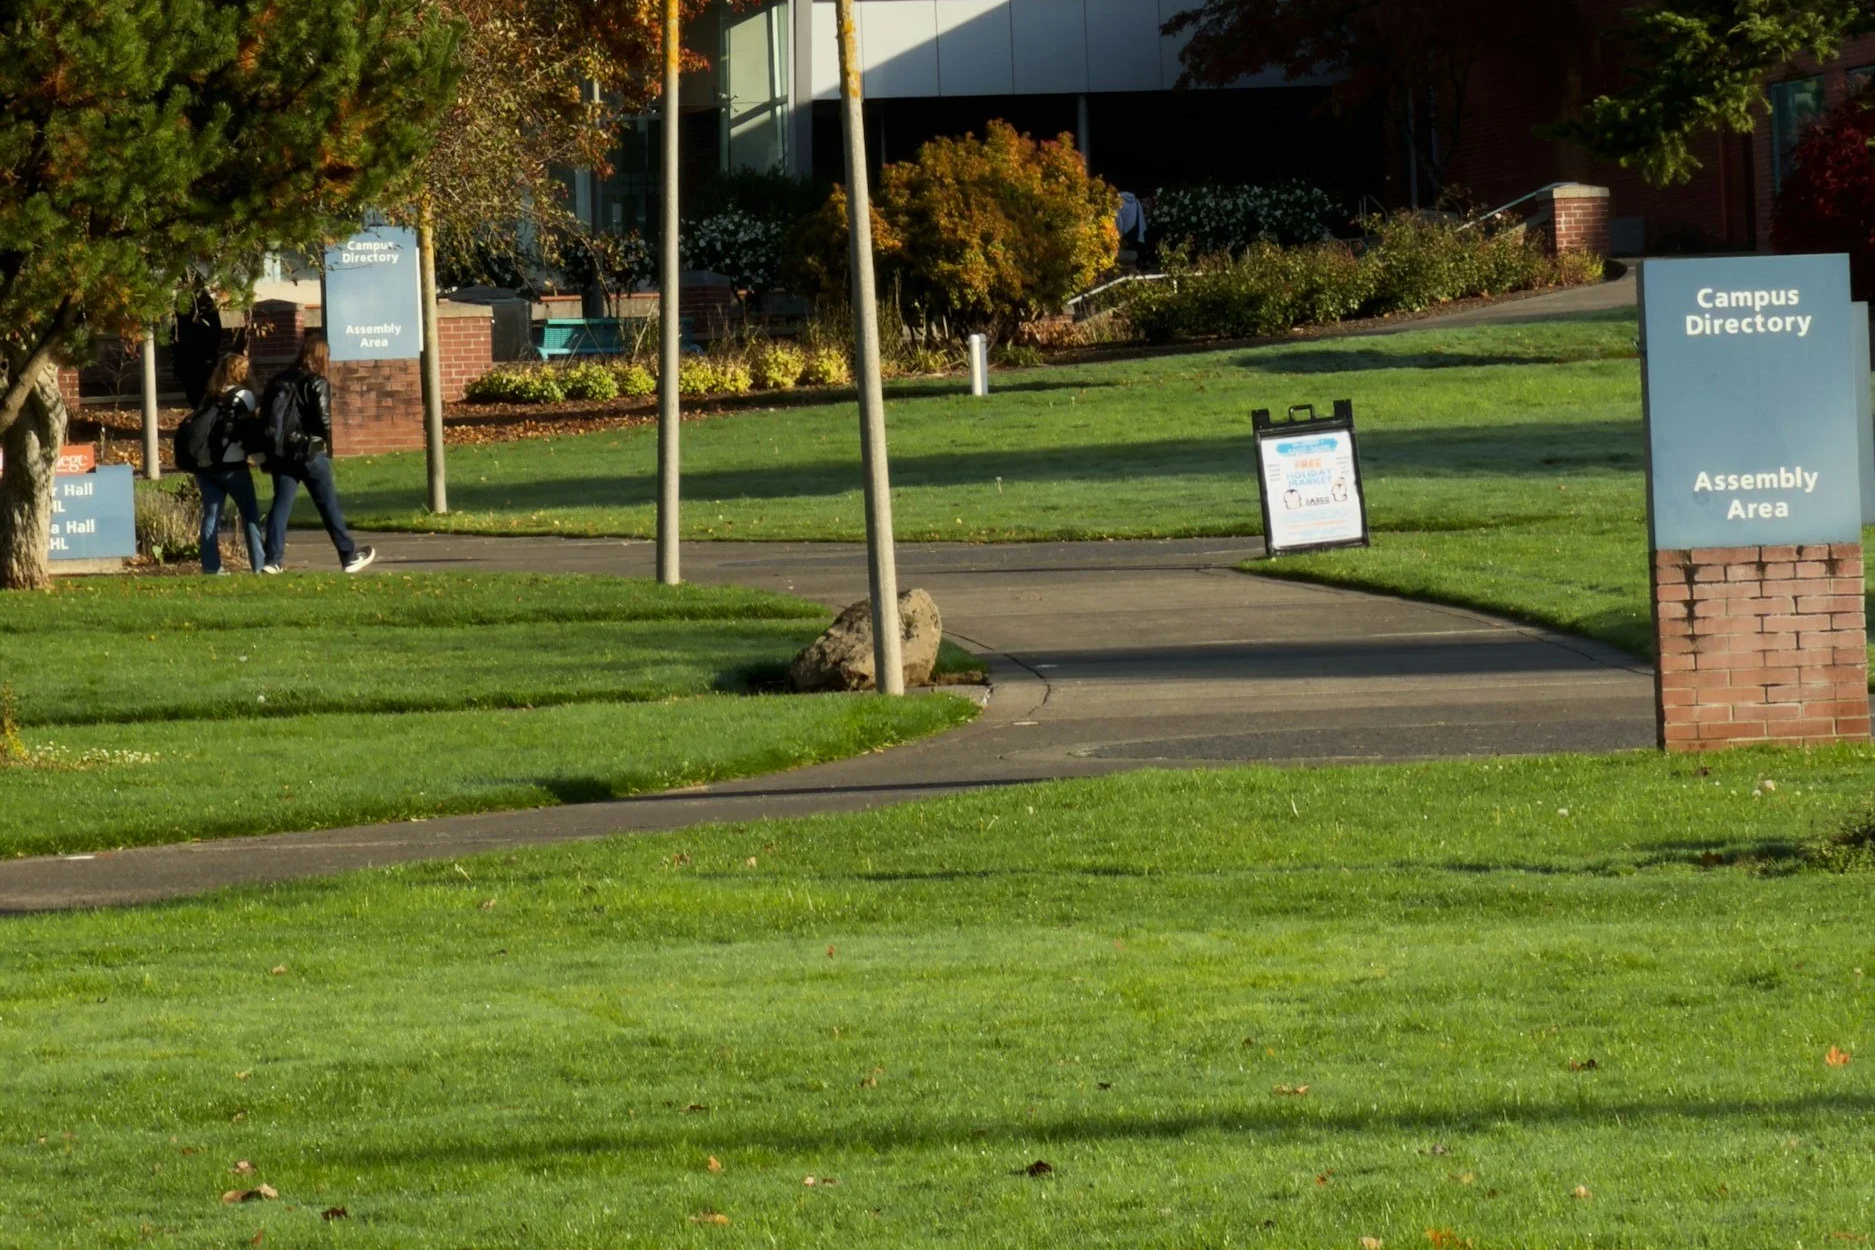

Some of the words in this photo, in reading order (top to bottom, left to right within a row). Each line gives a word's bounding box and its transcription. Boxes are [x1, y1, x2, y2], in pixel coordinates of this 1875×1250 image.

[347, 241, 395, 253] Campus
[342, 252, 400, 264] Directory
[1697, 288, 1800, 312] Campus
[345, 322, 402, 336] Assembly
[1685, 314, 1812, 337] Directory
[360, 337, 389, 348] Area
[1694, 466, 1819, 493] Assembly
[64, 482, 94, 497] Hall
[1727, 499, 1790, 520] Area
[66, 519, 96, 534] Hall
